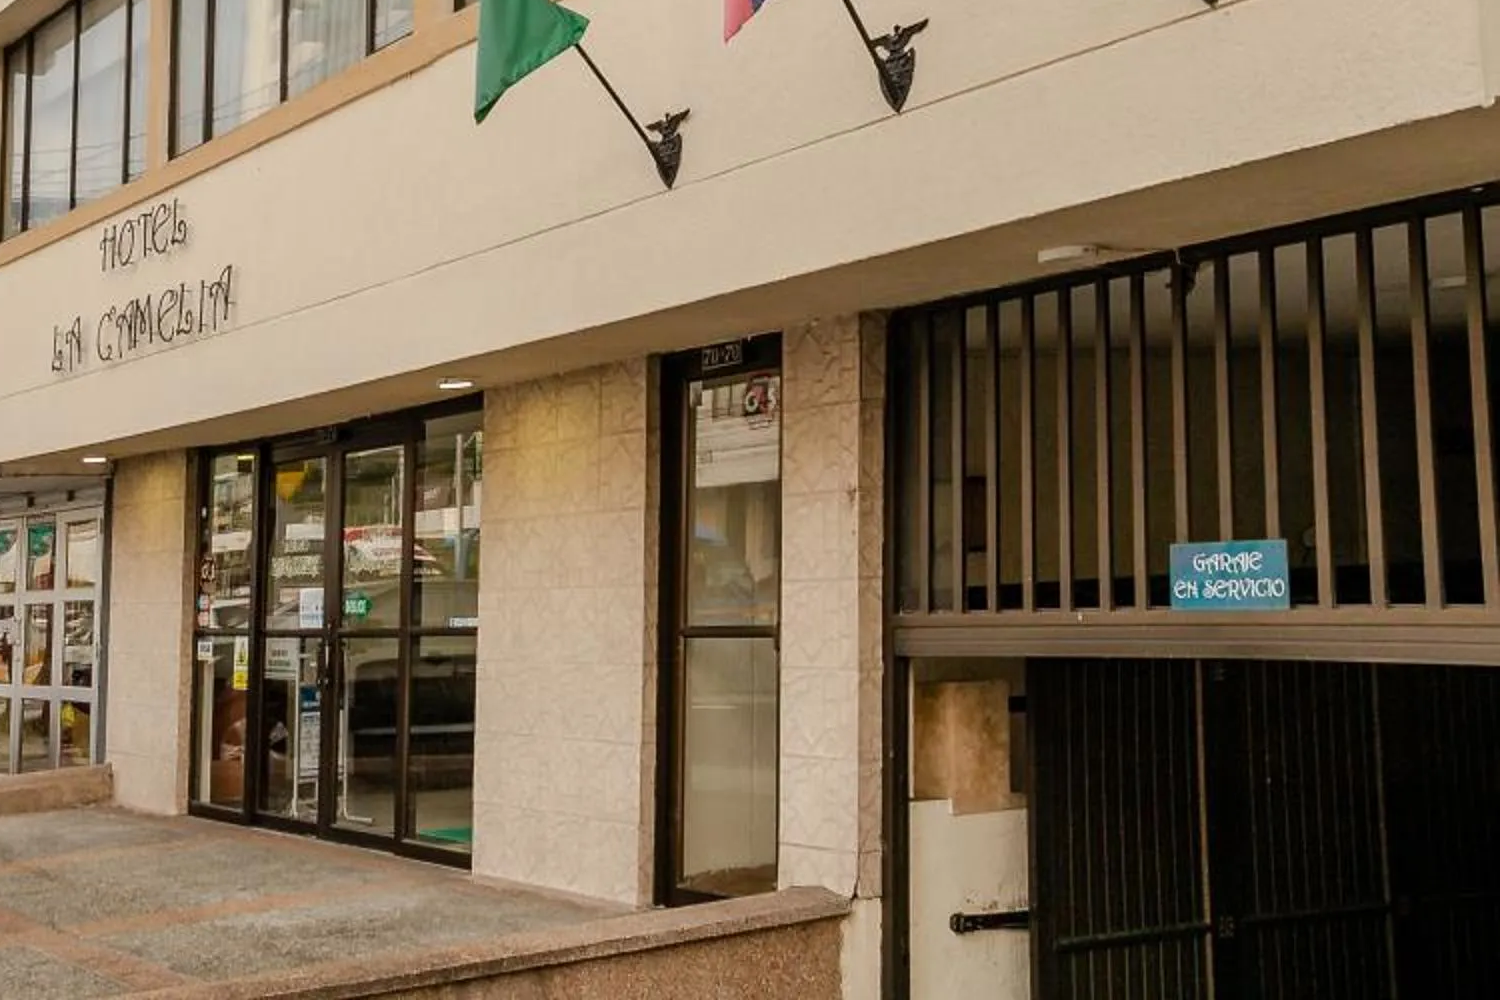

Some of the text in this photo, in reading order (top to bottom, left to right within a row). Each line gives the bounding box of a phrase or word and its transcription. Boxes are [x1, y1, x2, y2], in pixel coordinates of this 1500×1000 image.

[100, 198, 188, 272] HOTEL
[50, 263, 236, 373] LA CAMELIA
[1192, 551, 1263, 574] GARAJE
[1173, 578, 1285, 600] EN SERVICIO
